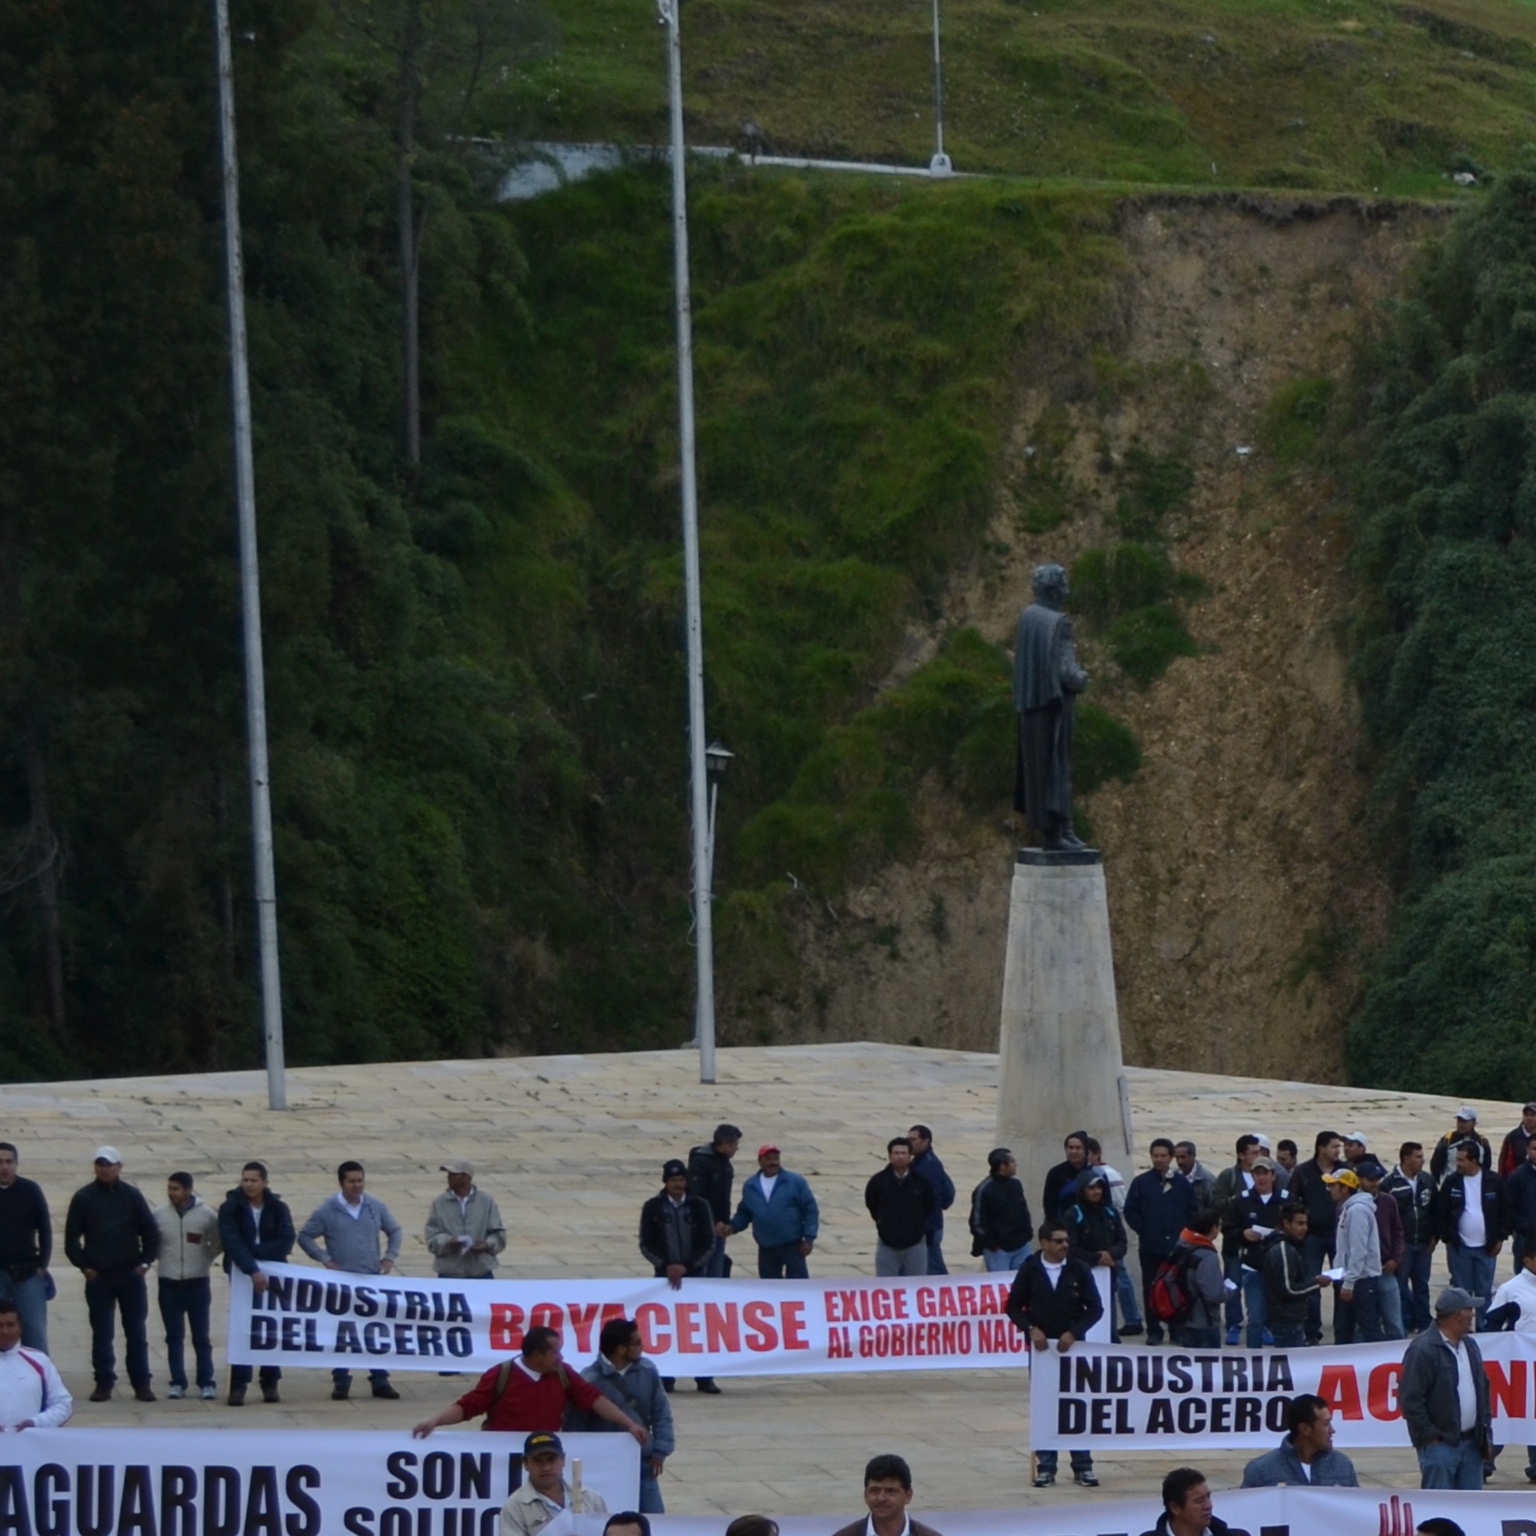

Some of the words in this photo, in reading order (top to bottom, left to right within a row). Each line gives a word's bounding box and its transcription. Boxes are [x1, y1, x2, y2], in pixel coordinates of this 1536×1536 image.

[252, 1275, 473, 1323] INDUSTRIA
[824, 1288, 909, 1322] EXIGE
[916, 1283, 1015, 1318] GARAN
[250, 1314, 324, 1352] DEL
[334, 1321, 474, 1358] ACERO
[489, 1301, 809, 1355] BOYCENSE
[827, 1325, 853, 1358] AL
[859, 1320, 971, 1358] GOBIERNO
[1058, 1355, 1294, 1393] INDUSTRIA
[1058, 1397, 1135, 1435] DEL
[1146, 1396, 1292, 1434] ACERO
[386, 1451, 492, 1500] SON
